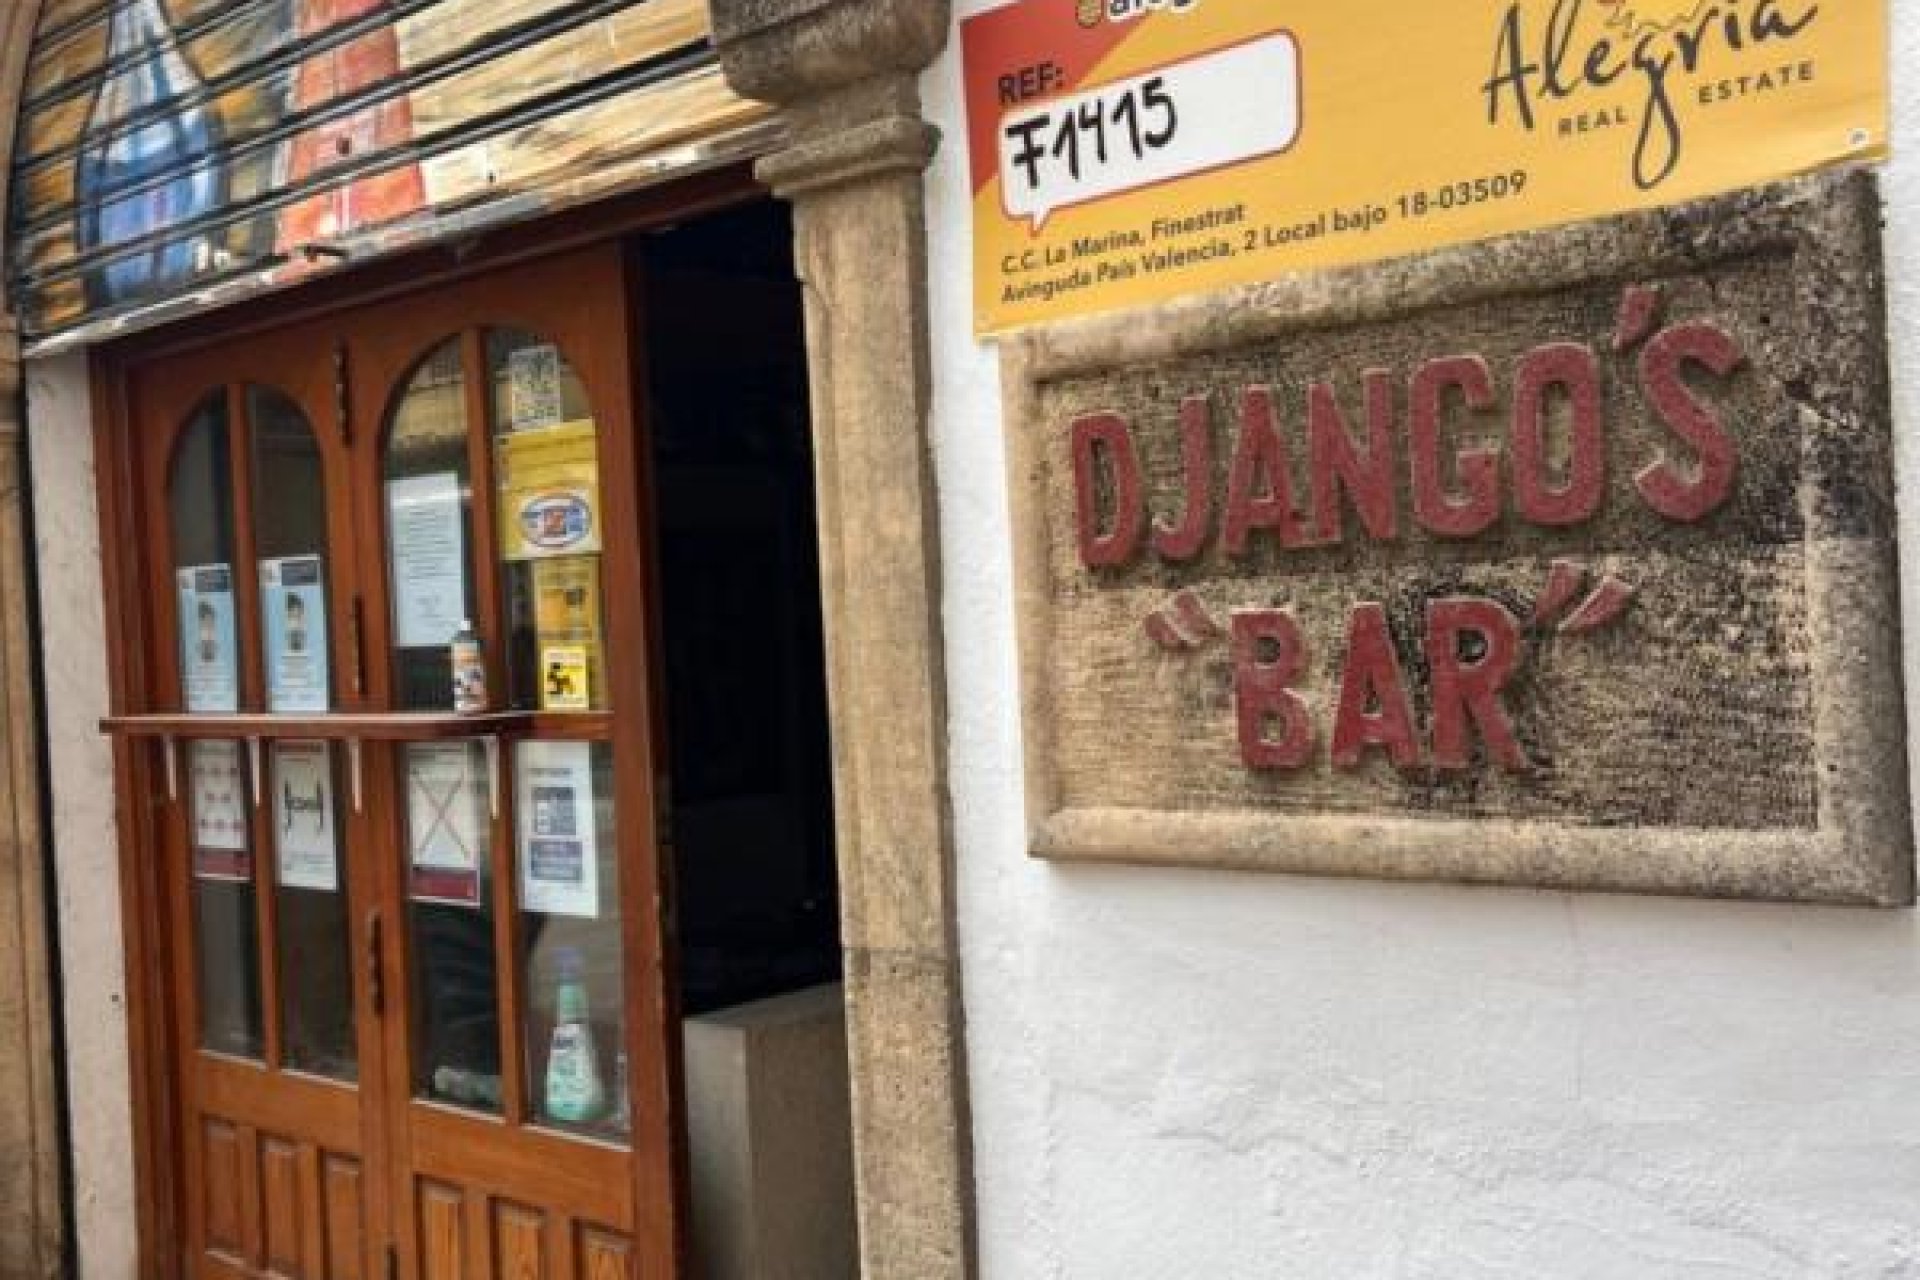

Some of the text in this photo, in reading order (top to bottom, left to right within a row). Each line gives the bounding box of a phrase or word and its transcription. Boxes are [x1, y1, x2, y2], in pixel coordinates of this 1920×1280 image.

[999, 62, 1064, 102] REF:
[1557, 60, 1815, 136] REAL ESTATE
[1004, 76, 1178, 188] F1415
[1001, 271, 1092, 301] Avinguda
[1244, 229, 1258, 251] 2
[1263, 213, 1326, 247] Local
[1332, 204, 1386, 231] bajo
[1395, 169, 1527, 219] 18-03509
[1045, 246, 1067, 266] La
[1151, 203, 1246, 240] Finestrat
[1069, 285, 1745, 569] DJANGO'S
